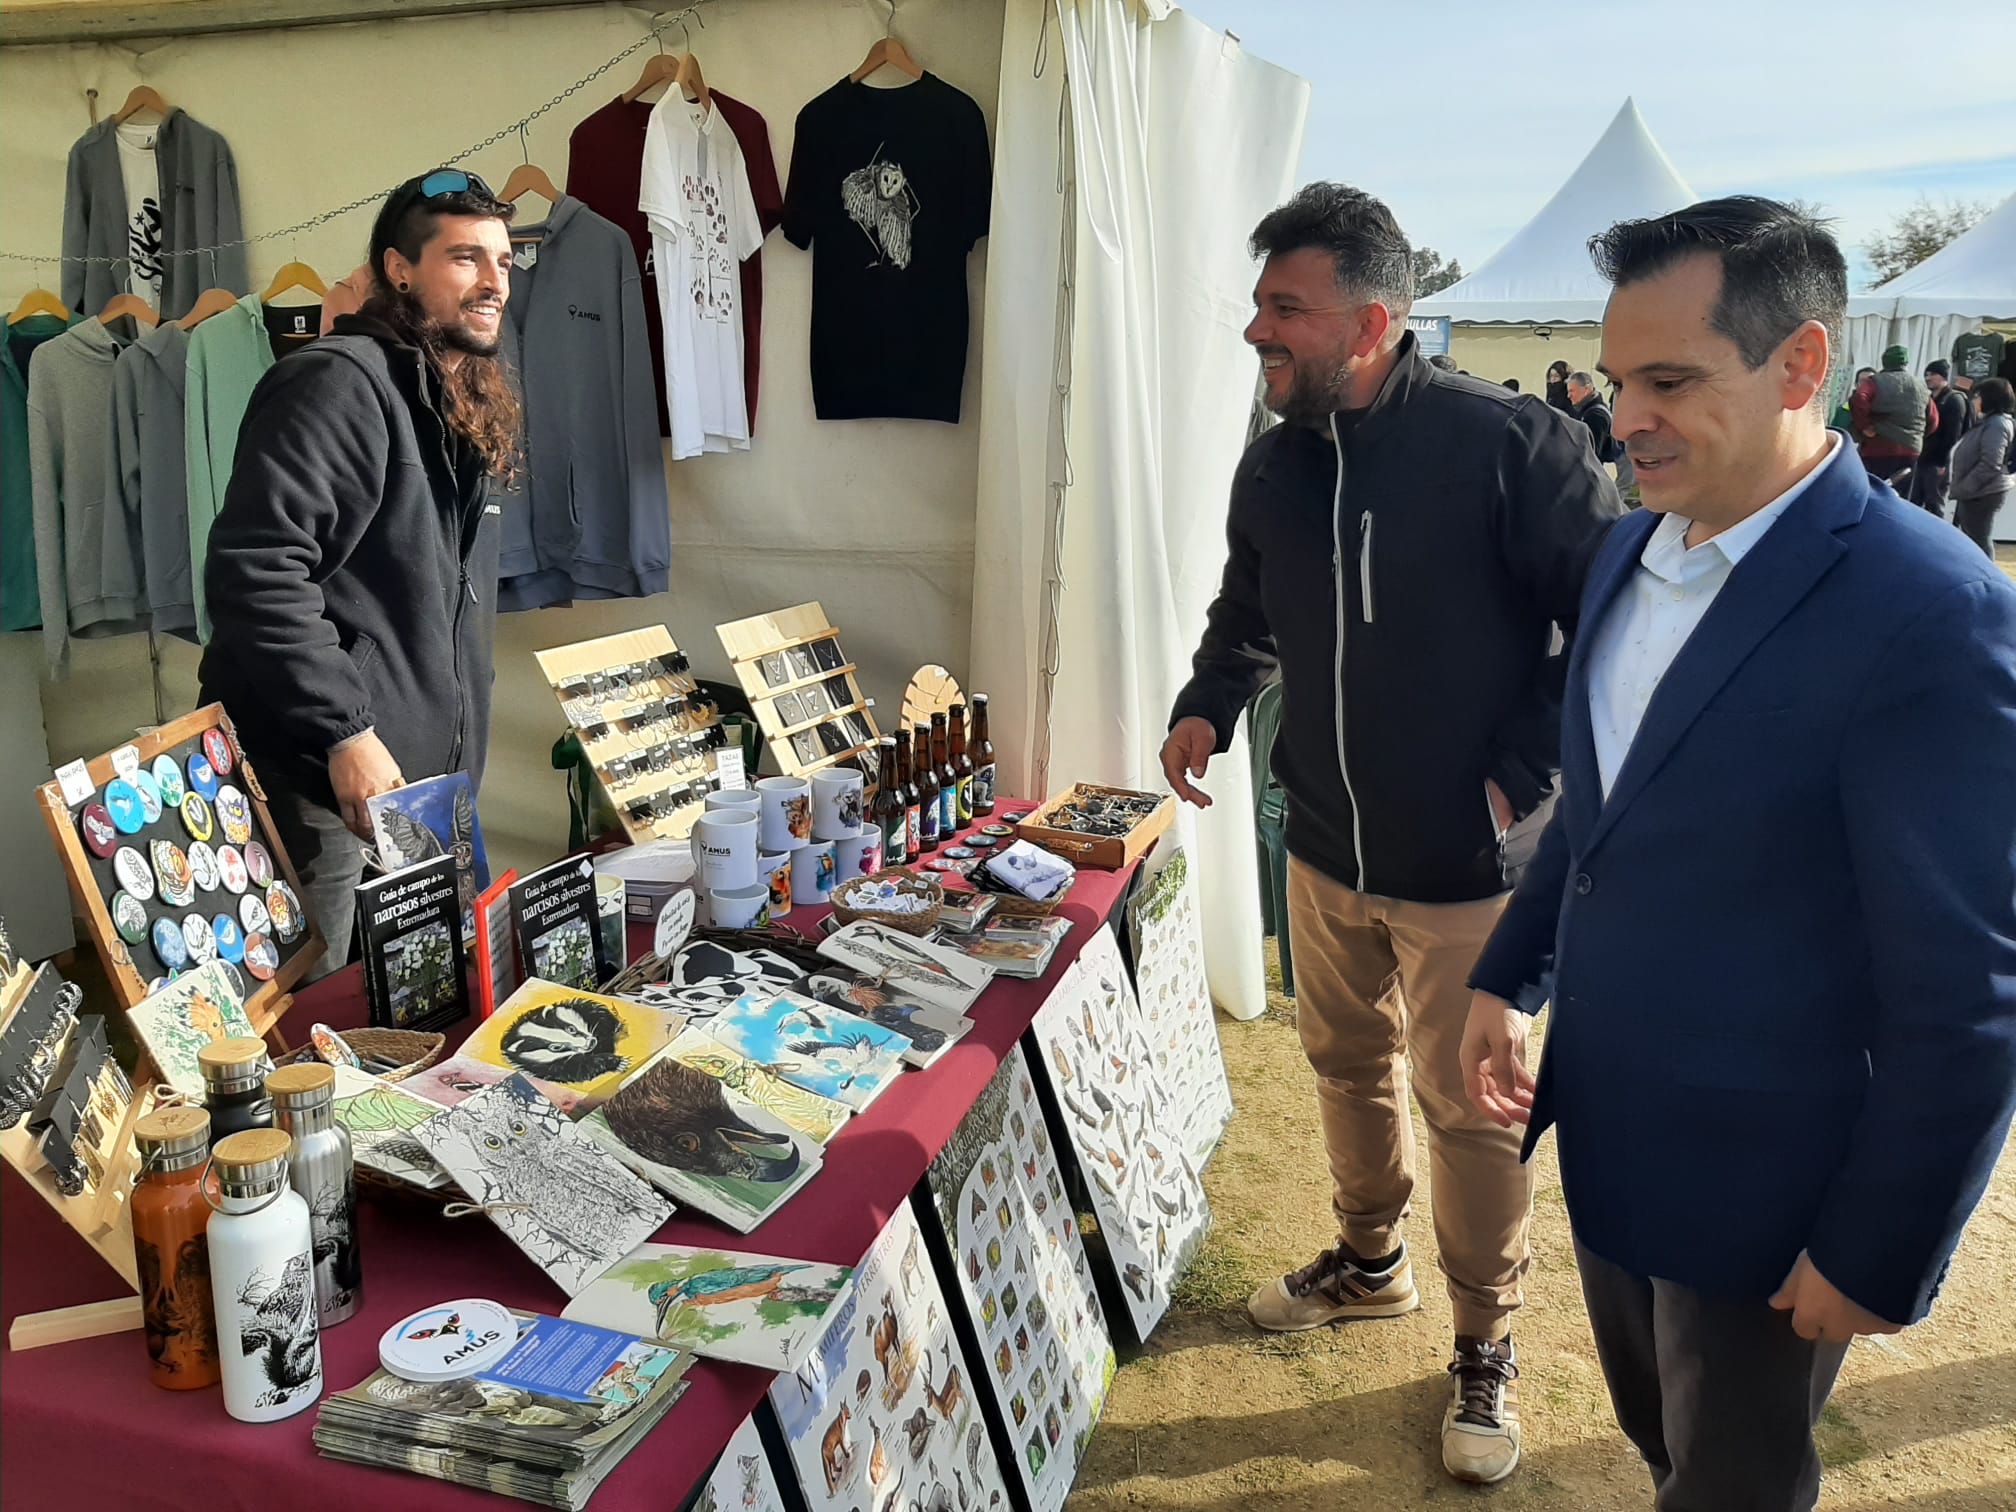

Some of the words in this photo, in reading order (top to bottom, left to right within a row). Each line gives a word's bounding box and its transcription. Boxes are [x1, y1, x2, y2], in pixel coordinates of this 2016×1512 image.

[577, 311, 601, 321] AMUS
[397, 884, 407, 896] de
[407, 877, 431, 891] campo
[540, 880, 549, 892] de
[548, 874, 569, 888] campo
[374, 896, 419, 925] narcisos
[419, 886, 454, 906] silvestres
[521, 892, 560, 922] narcisos
[560, 882, 591, 903] silvestres
[541, 902, 580, 926] Extremadura
[397, 906, 440, 930] Extremadura
[857, 1234, 895, 1299] TERRESTRES
[443, 1330, 500, 1365] AMUS
